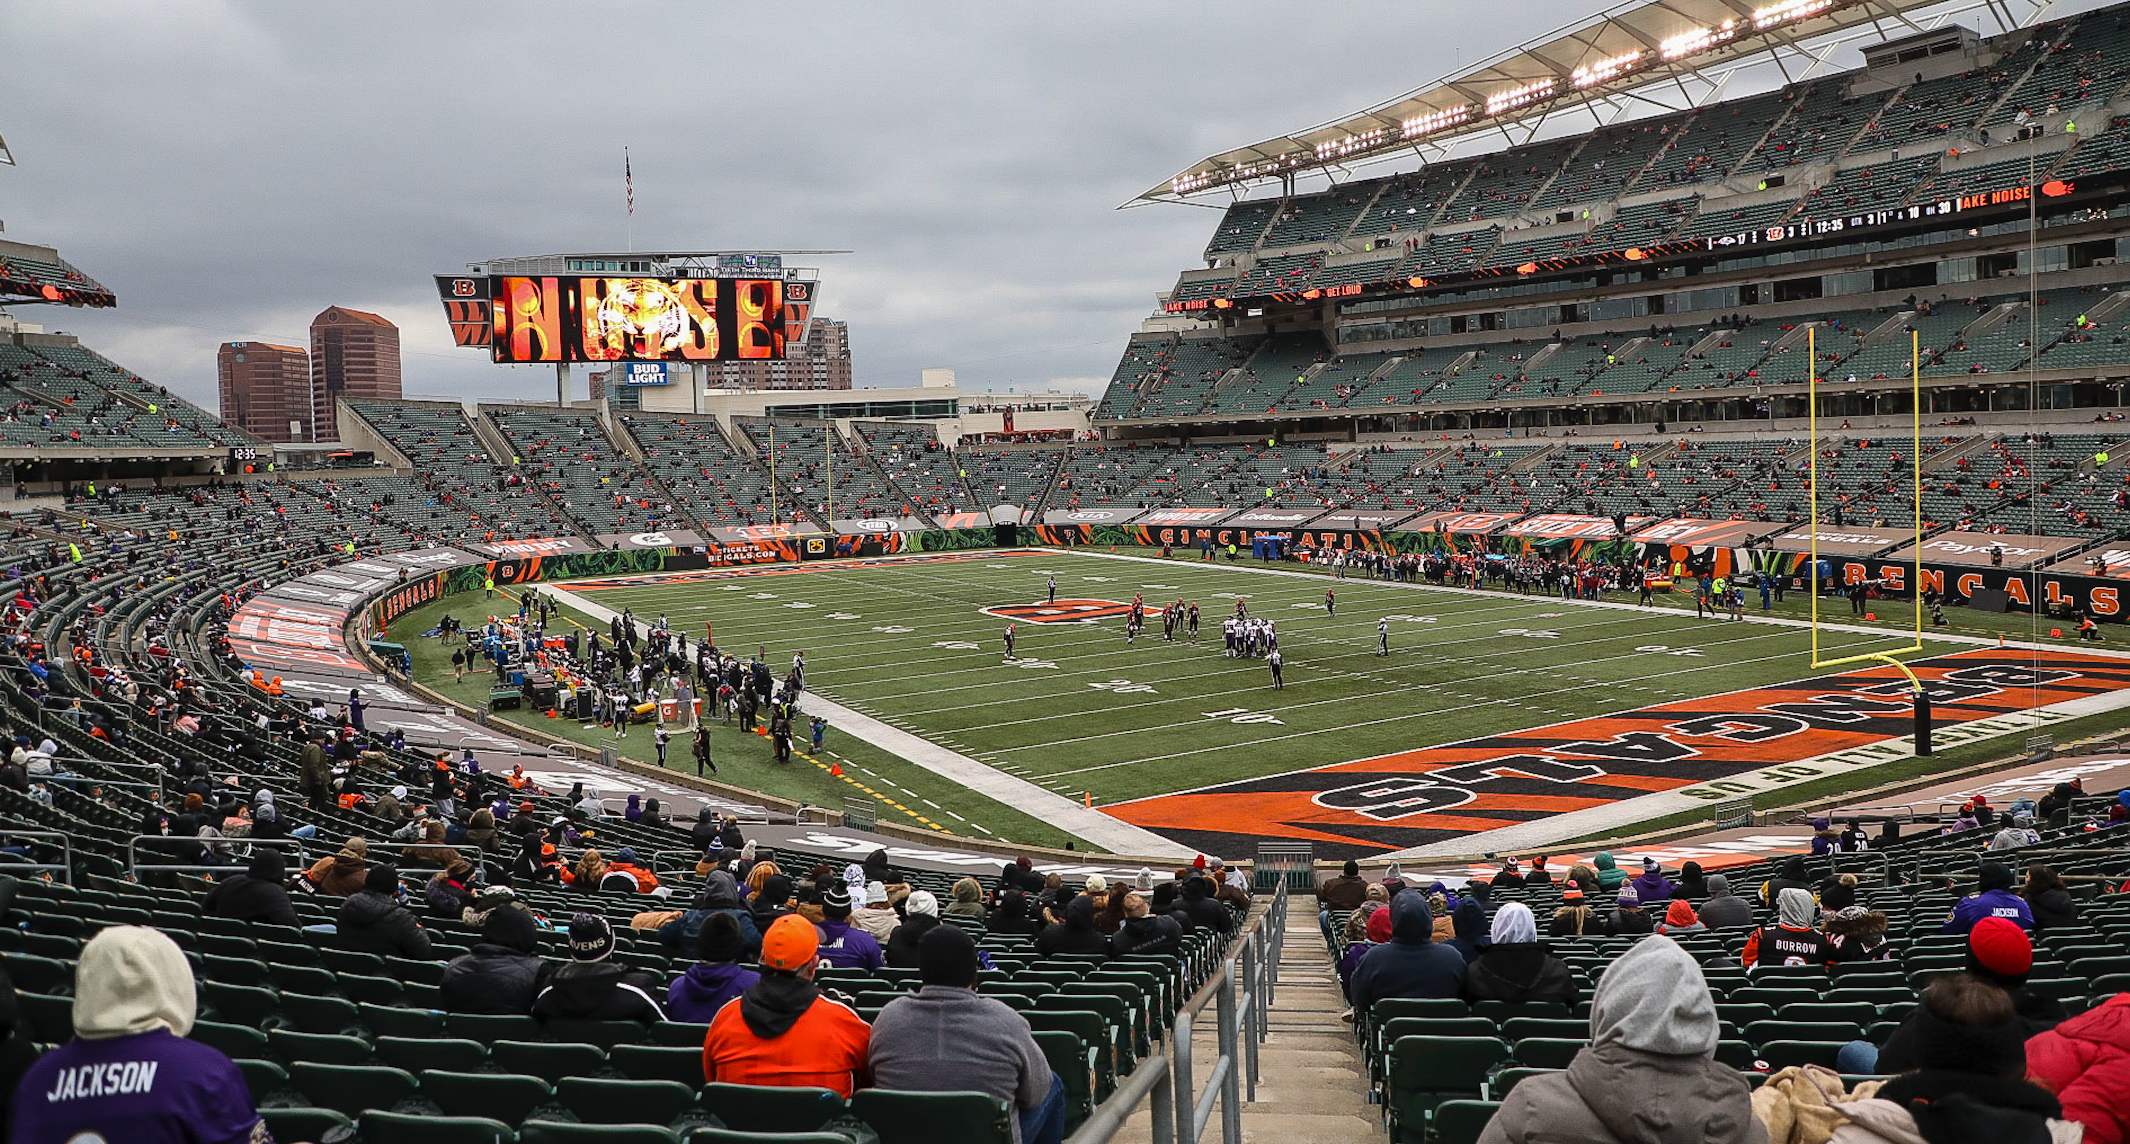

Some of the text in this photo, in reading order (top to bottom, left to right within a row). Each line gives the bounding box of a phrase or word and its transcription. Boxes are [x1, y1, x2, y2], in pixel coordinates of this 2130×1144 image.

[1961, 186, 2031, 210] AKE NOISE
[1908, 206, 1920, 219] 10
[1938, 201, 1951, 214] 30
[1737, 233, 1747, 245] 17
[1787, 226, 1795, 238] 3
[1816, 218, 1844, 234] 12:35
[1867, 213, 1875, 225] 3
[1326, 284, 1362, 298] GET LOUD
[1185, 300, 1208, 311] NOISE
[633, 363, 660, 374] BUD
[628, 372, 666, 384] LIGHT
[234, 448, 256, 460] 12:35
[1637, 525, 1708, 539] DEY
[1782, 533, 1894, 545] BENGALS
[483, 539, 574, 554] WHO DEY
[809, 540, 823, 552] 25
[1843, 561, 2120, 615] BENGALS
[387, 578, 435, 620] BENGALS
[663, 706, 672, 715] G
[1991, 907, 2020, 918] JACKSON
[1131, 934, 1167, 952] BENGALS
[1775, 939, 1818, 955] BURROW
[47, 1060, 159, 1103] JACKSON
